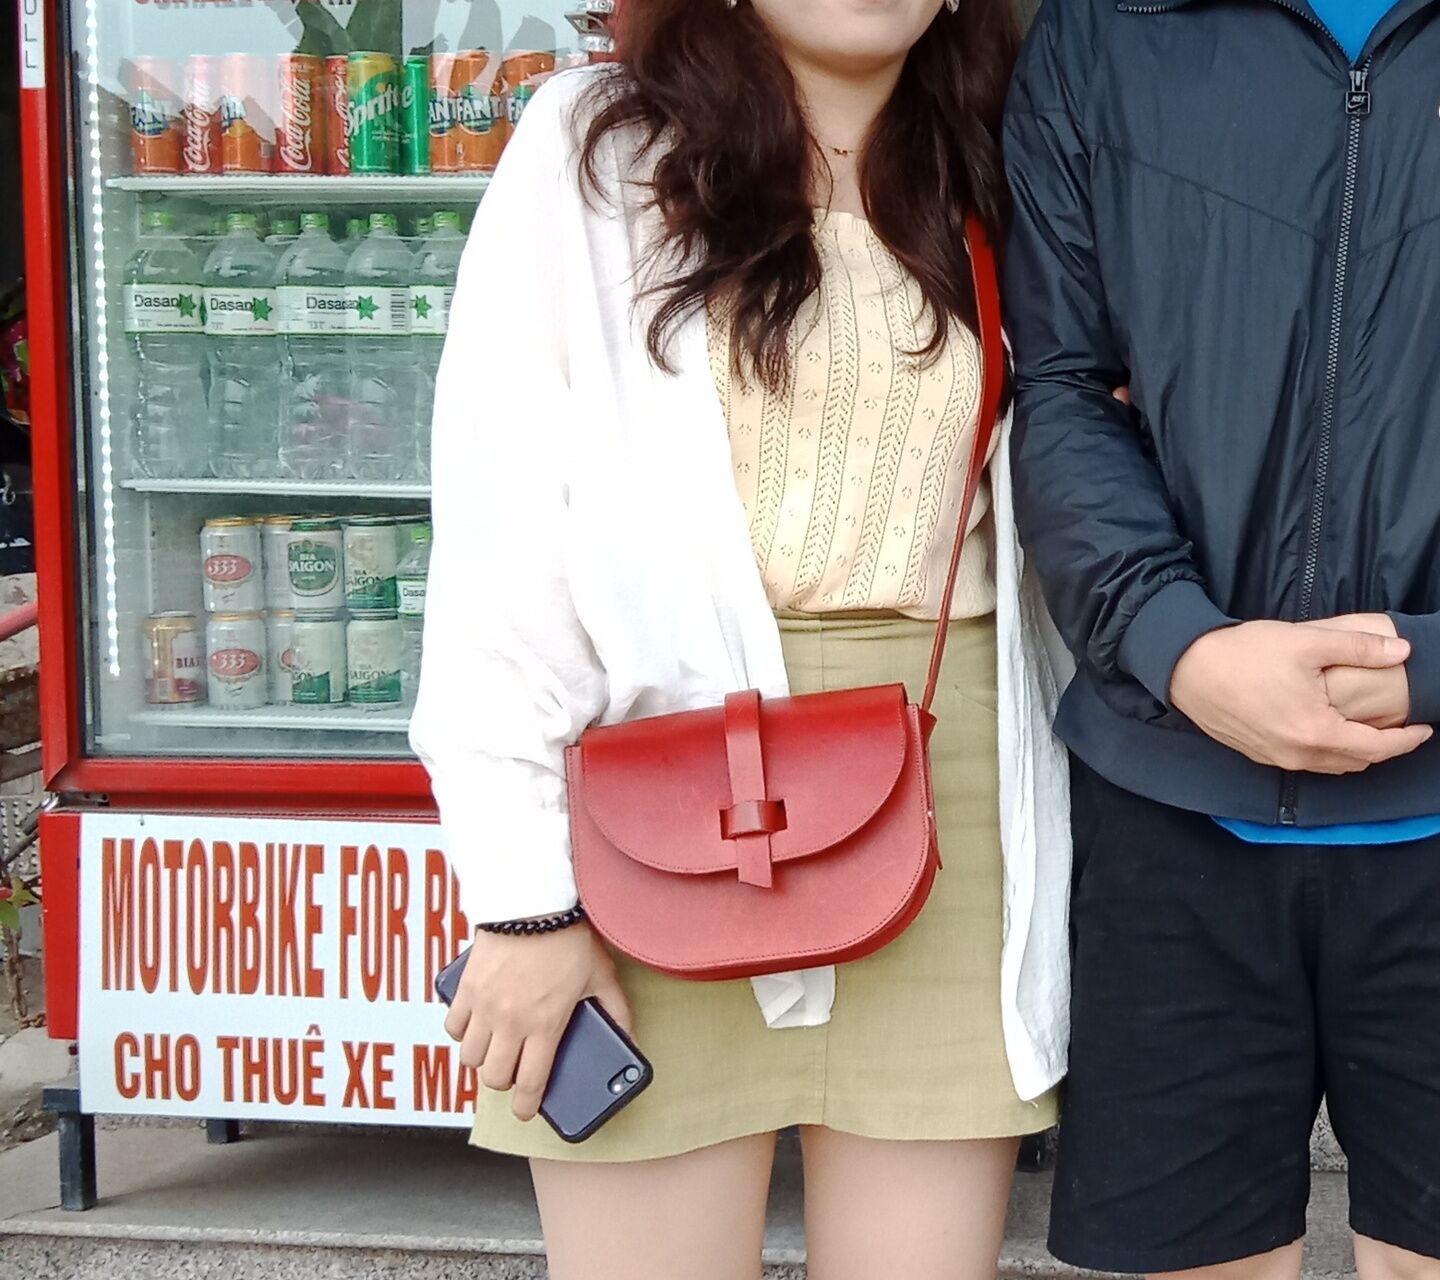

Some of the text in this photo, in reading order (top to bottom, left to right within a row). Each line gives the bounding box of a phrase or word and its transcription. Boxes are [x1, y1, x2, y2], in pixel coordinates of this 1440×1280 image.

[102, 836, 325, 998] MOTORBIKE
[339, 844, 409, 1002] FOR
[114, 1031, 202, 1102] CHO
[216, 1024, 326, 1107] THUÊ
[342, 1040, 396, 1113] XE
